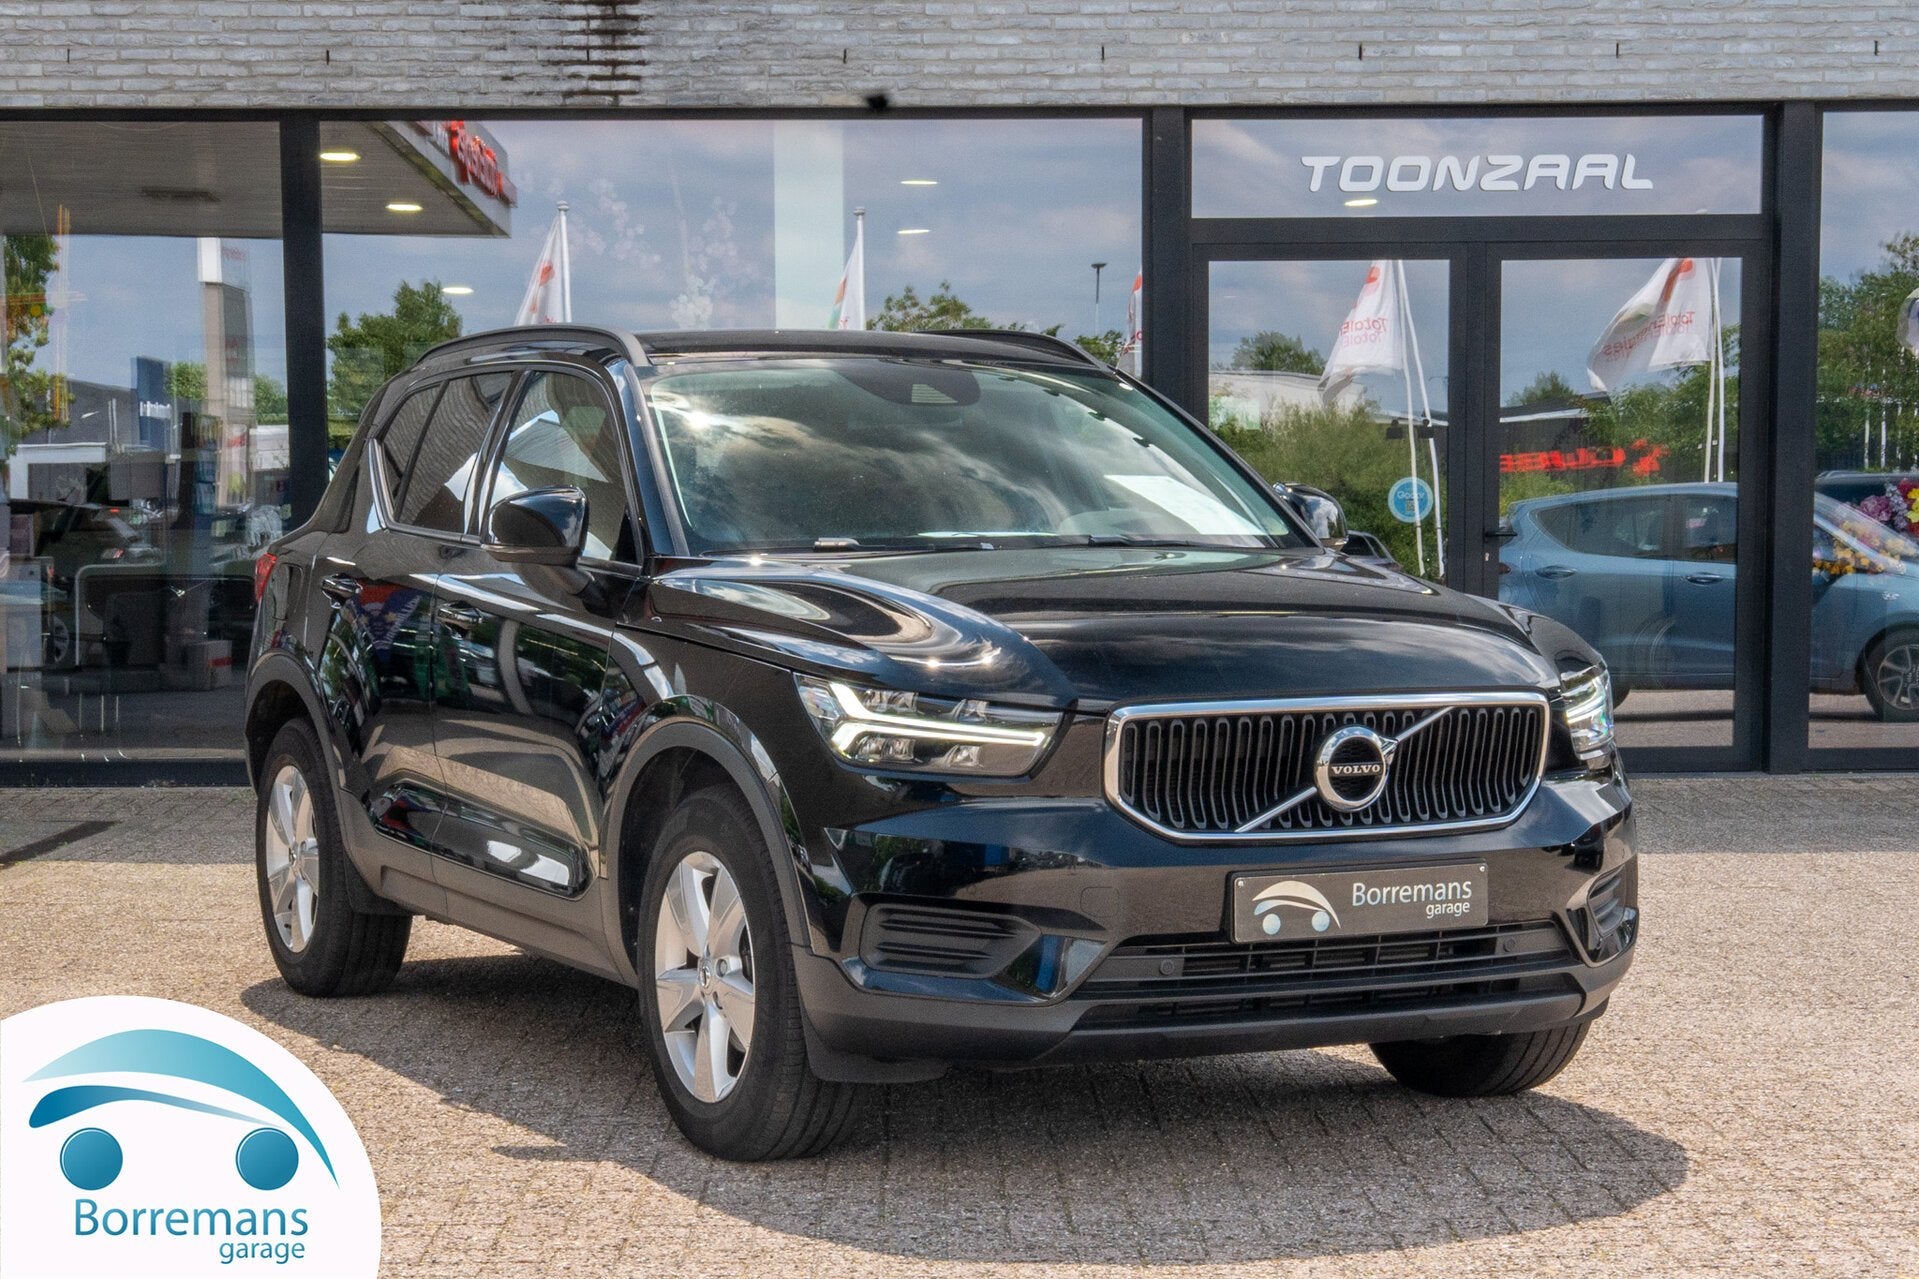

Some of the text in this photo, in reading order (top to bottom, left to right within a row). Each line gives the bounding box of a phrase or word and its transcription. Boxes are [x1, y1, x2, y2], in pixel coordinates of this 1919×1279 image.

[1301, 153, 1654, 192] TOONZAAL
[1331, 764, 1381, 775] VOLVO
[1352, 880, 1472, 907] Borremans
[1426, 901, 1471, 919] garage
